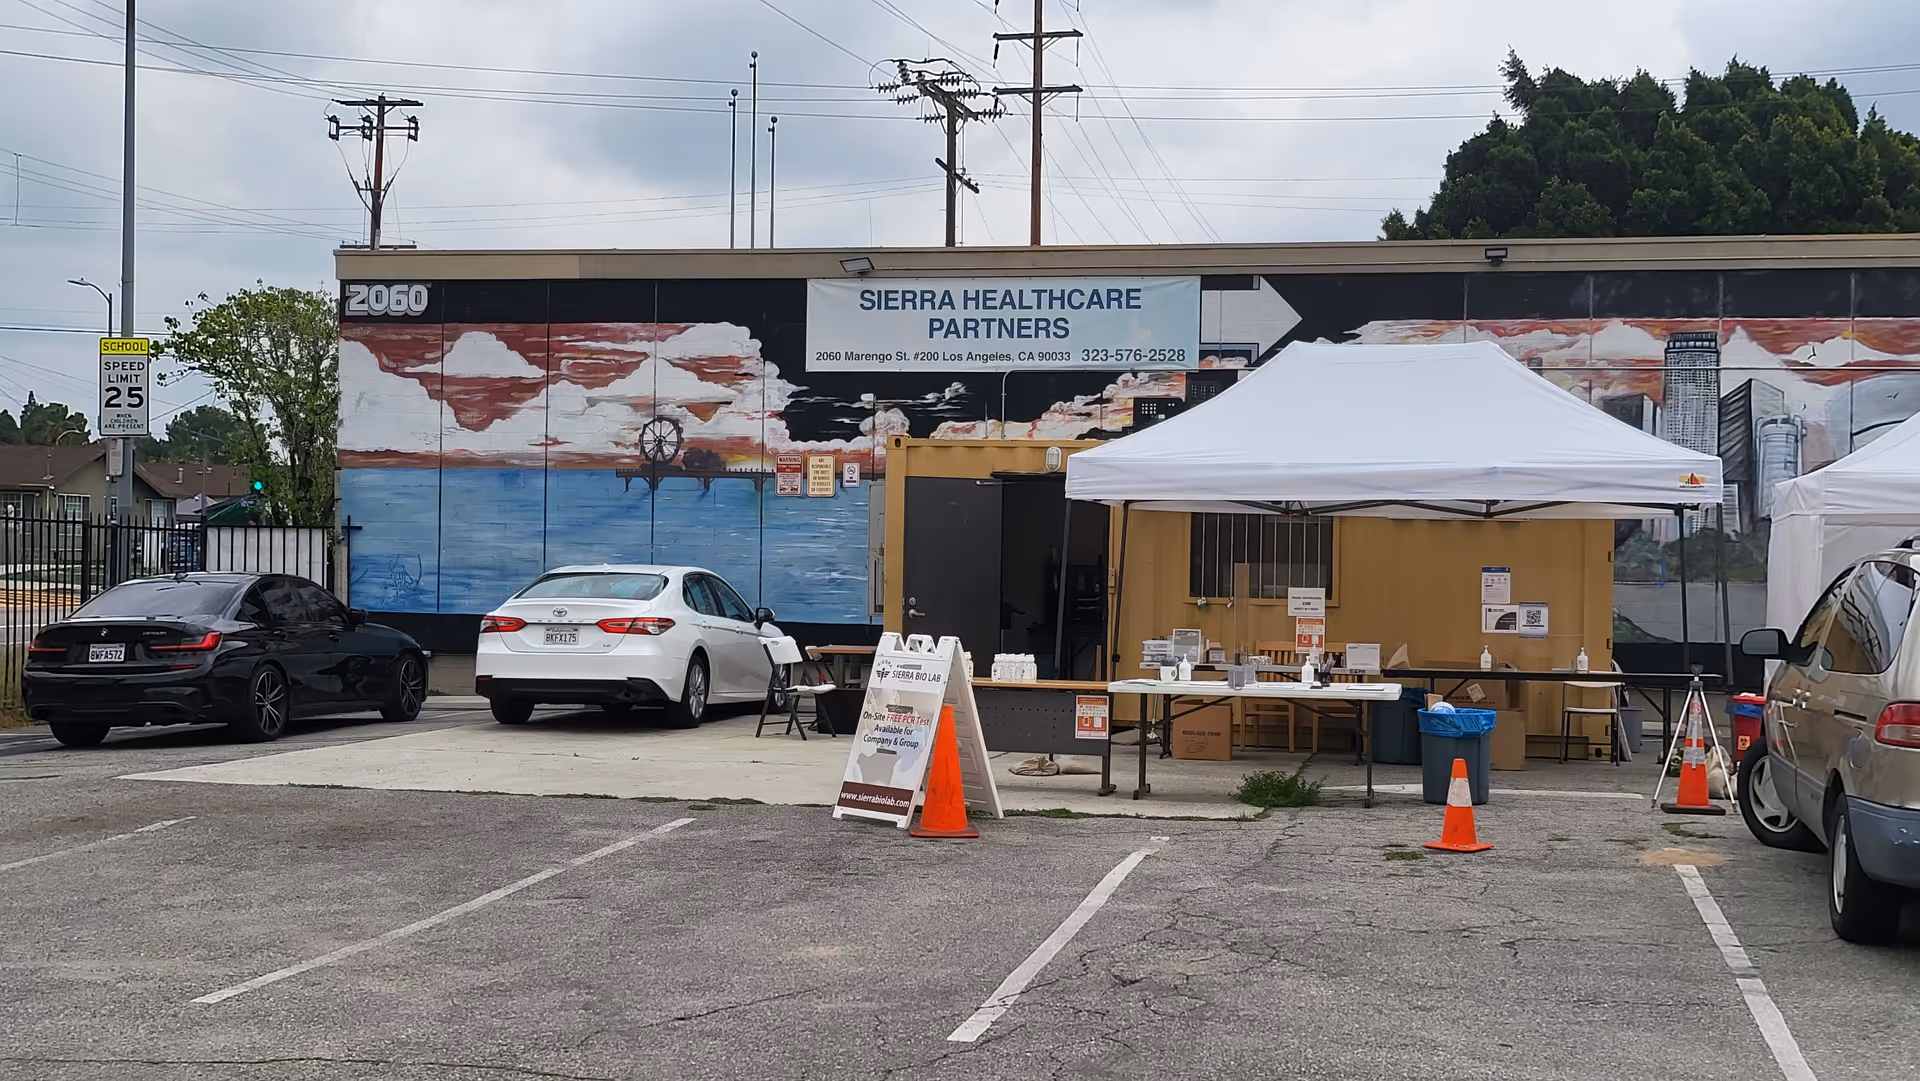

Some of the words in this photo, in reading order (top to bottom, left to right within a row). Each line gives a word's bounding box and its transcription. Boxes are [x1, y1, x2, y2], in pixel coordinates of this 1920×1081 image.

[345, 284, 428, 316] 2060
[859, 289, 956, 311] SIERRA
[963, 288, 1142, 310] HEALTHCARE
[928, 317, 1070, 339] PARTNERS
[103, 342, 146, 352] SCHOOL
[815, 351, 842, 361] 2060
[844, 351, 892, 364] Marengo
[895, 351, 910, 361] St.
[913, 351, 939, 361] #200
[942, 351, 963, 361] Los
[966, 351, 1015, 364] Angeles,
[1018, 351, 1035, 361] CA
[1038, 351, 1071, 361] 90033
[1081, 348, 1186, 362] 323-576-2528
[104, 361, 145, 371] SPEED
[108, 373, 141, 383] LIMIT
[104, 386, 144, 409] 25
[545, 633, 577, 642] 8KFX175
[90, 649, 123, 660] 8WFA572
[892, 670, 914, 680] SIERRA
[915, 672, 928, 682] BIO
[928, 673, 942, 682] LAB
[862, 711, 886, 721] On-Site
[886, 714, 902, 723] FREE
[902, 715, 916, 724] PCR
[916, 716, 930, 726] Test
[874, 724, 904, 735] Available
[904, 726, 914, 736] for
[863, 734, 894, 747] Company
[892, 738, 898, 746] &
[900, 738, 920, 750] Group
[840, 791, 910, 808] www.sierrabiolab.com
